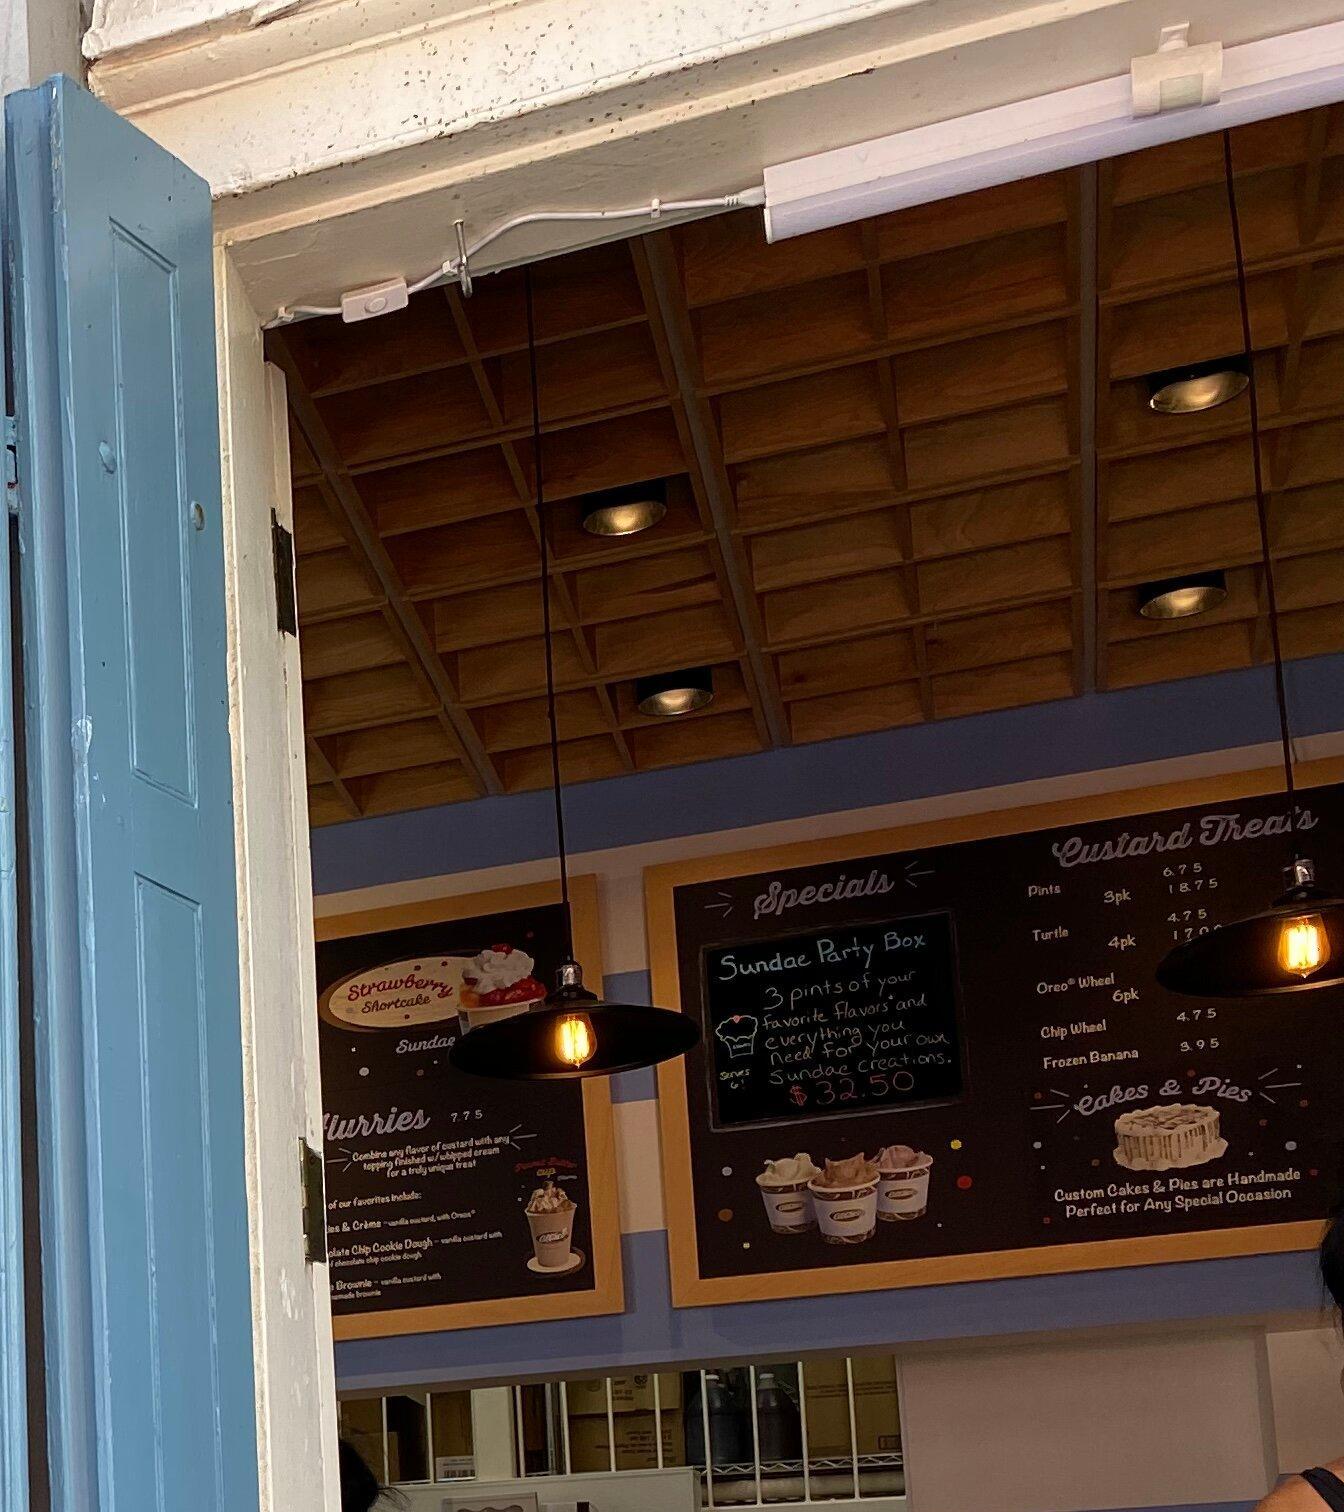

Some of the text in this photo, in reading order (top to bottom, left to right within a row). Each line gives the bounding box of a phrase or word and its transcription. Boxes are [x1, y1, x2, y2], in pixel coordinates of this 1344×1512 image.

[1052, 824, 1192, 868] Custard
[753, 869, 894, 920] Specials
[1028, 884, 1061, 897] Pints
[1103, 888, 1132, 904] 3pk
[1032, 926, 1069, 942] Turtle
[1108, 935, 1137, 951] 4pk
[718, 931, 926, 981] Sundae Party Box
[348, 974, 453, 1001] Strawberry
[763, 971, 916, 1010] 3 pints of your
[1078, 973, 1115, 989] Wheel
[1112, 987, 1140, 1001] 6pk
[362, 994, 432, 1014] Shortcake
[762, 993, 927, 1030] favorite flavors and
[764, 1021, 905, 1053] everything you
[1040, 1019, 1107, 1040] Chip Wheel
[822, 1042, 854, 1060] for
[865, 1035, 910, 1057] your
[915, 1033, 949, 1045] own
[1043, 1048, 1139, 1070] Frozen Banana
[1073, 1076, 1252, 1116] Cakes & Pies
[1054, 1168, 1301, 1202] Custom Cakes & Pies are Handmade
[1066, 1187, 1292, 1219] Perfect for Any Special Occasion
[404, 1236, 433, 1250] Dough
